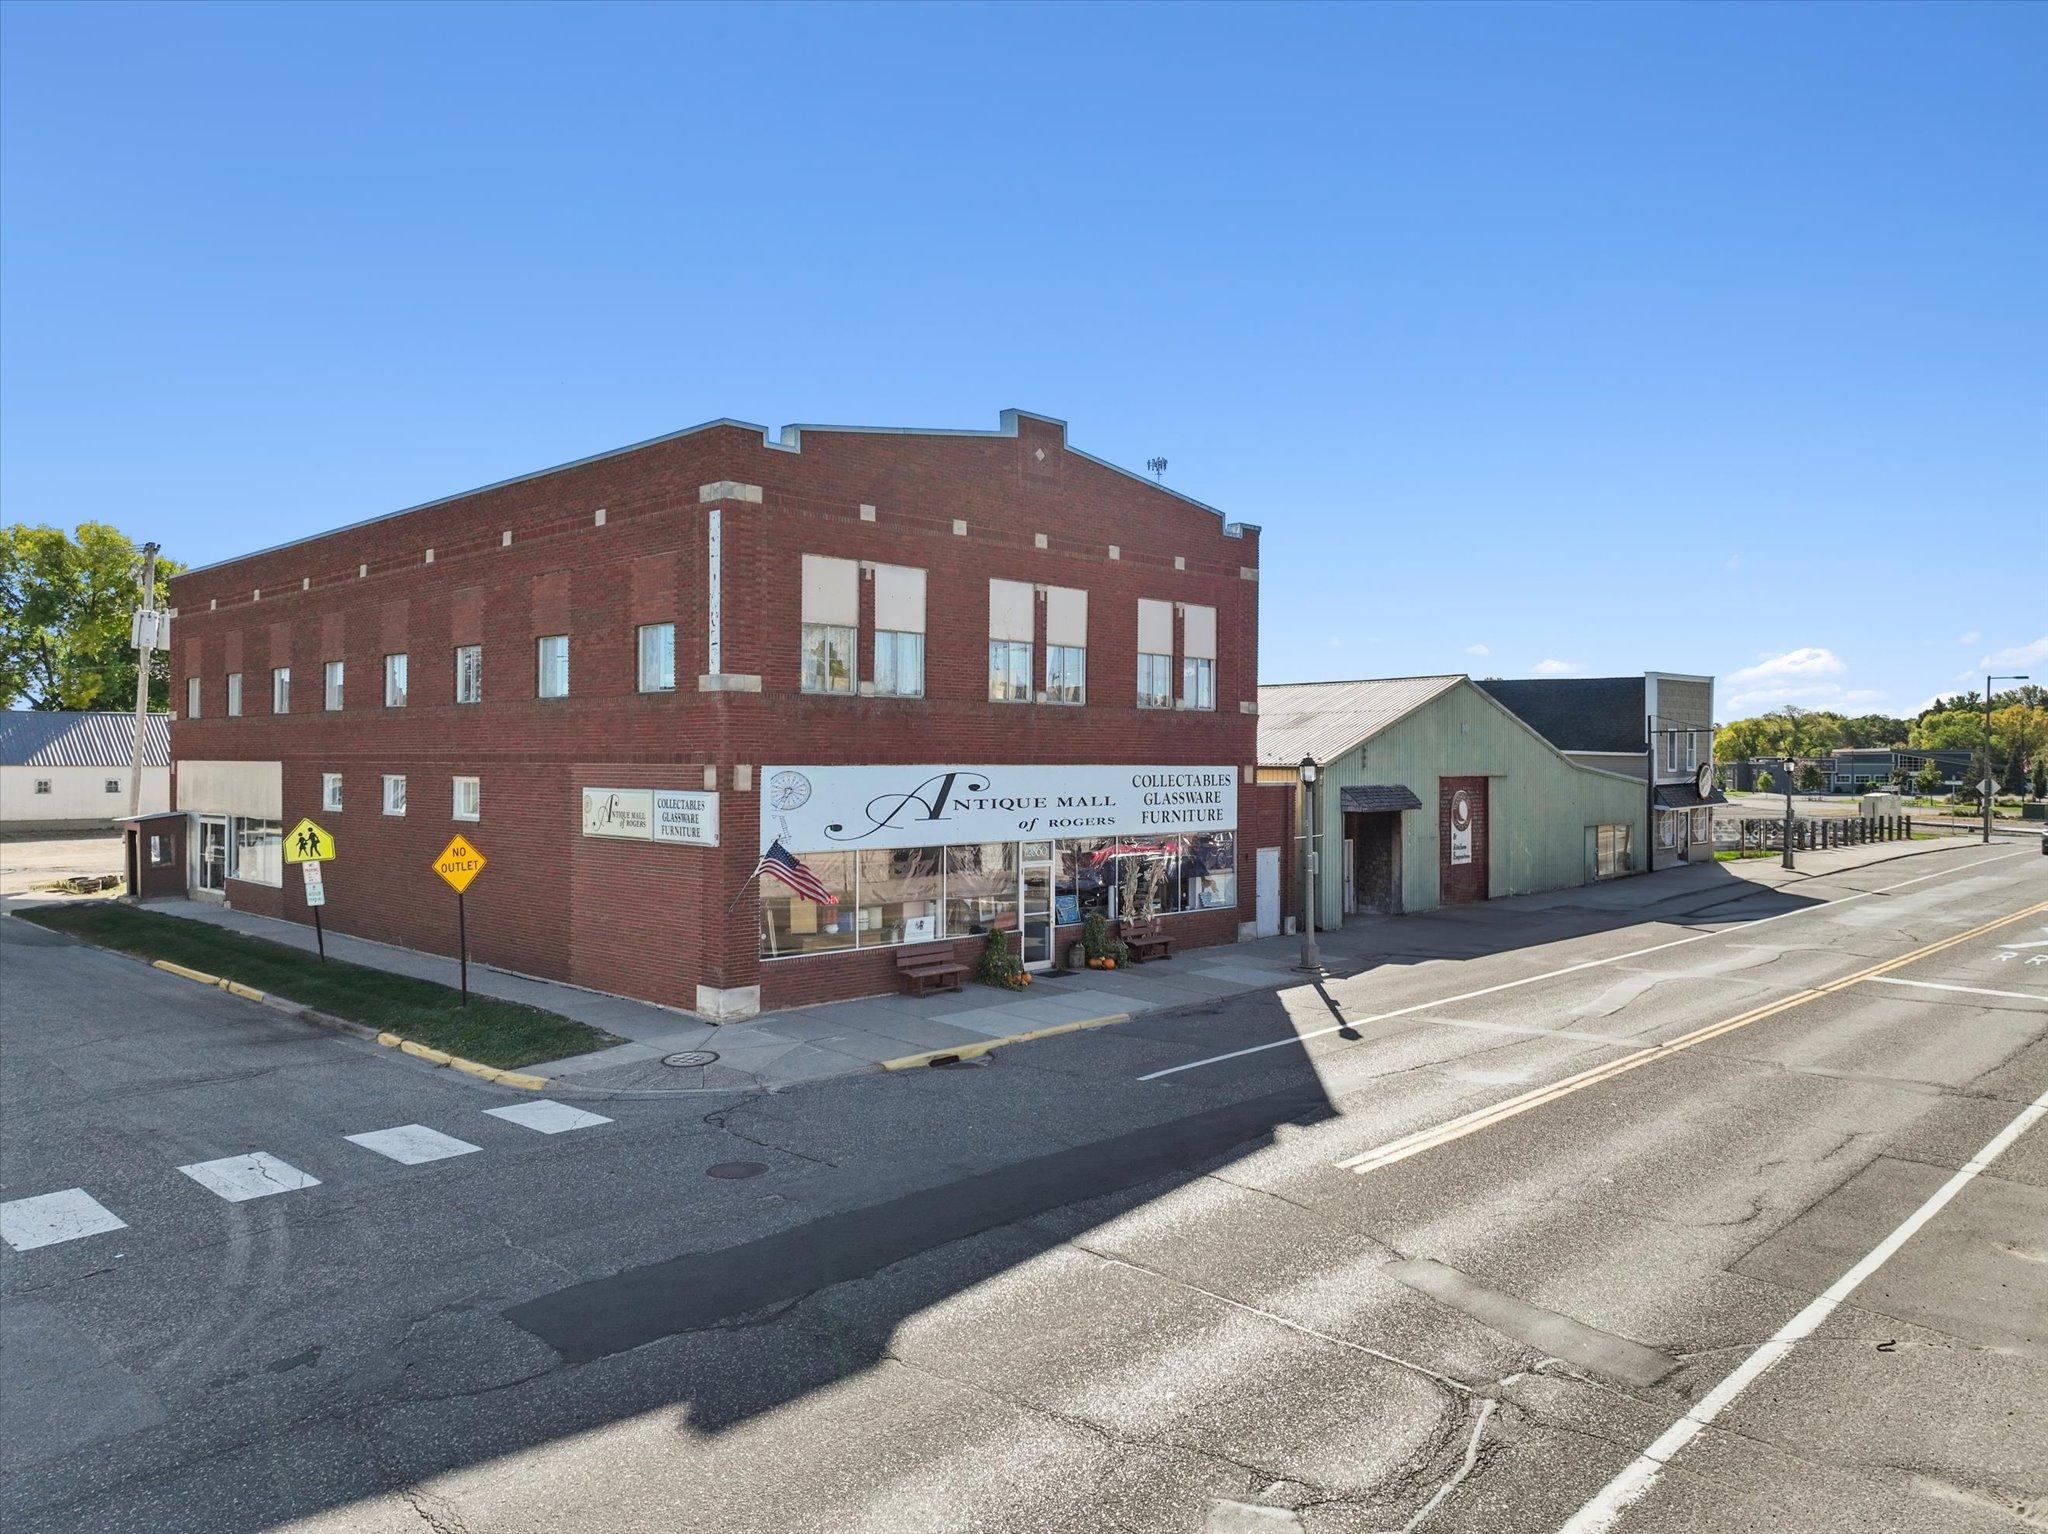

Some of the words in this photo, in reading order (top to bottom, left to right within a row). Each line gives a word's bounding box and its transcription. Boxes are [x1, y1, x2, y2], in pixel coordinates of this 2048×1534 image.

[1132, 773, 1232, 789] COLLECTABLES
[657, 798, 706, 812] COLLECTABLES
[1143, 790, 1222, 806] GLASSWARE
[592, 793, 631, 832] ANTIQUE
[631, 811, 646, 820] MALL
[824, 772, 1047, 841] ANTIQUE
[1056, 796, 1116, 808] MALL
[662, 811, 699, 825] GLASSWARE
[1141, 808, 1224, 824] FURNITURE
[620, 819, 626, 829] of
[626, 819, 647, 829] ROGERS
[661, 825, 701, 838] FURNITURE
[1018, 817, 1039, 832] of
[1049, 816, 1116, 828] ROGERS
[452, 847, 466, 858] NO
[441, 860, 478, 873] OUTLET
